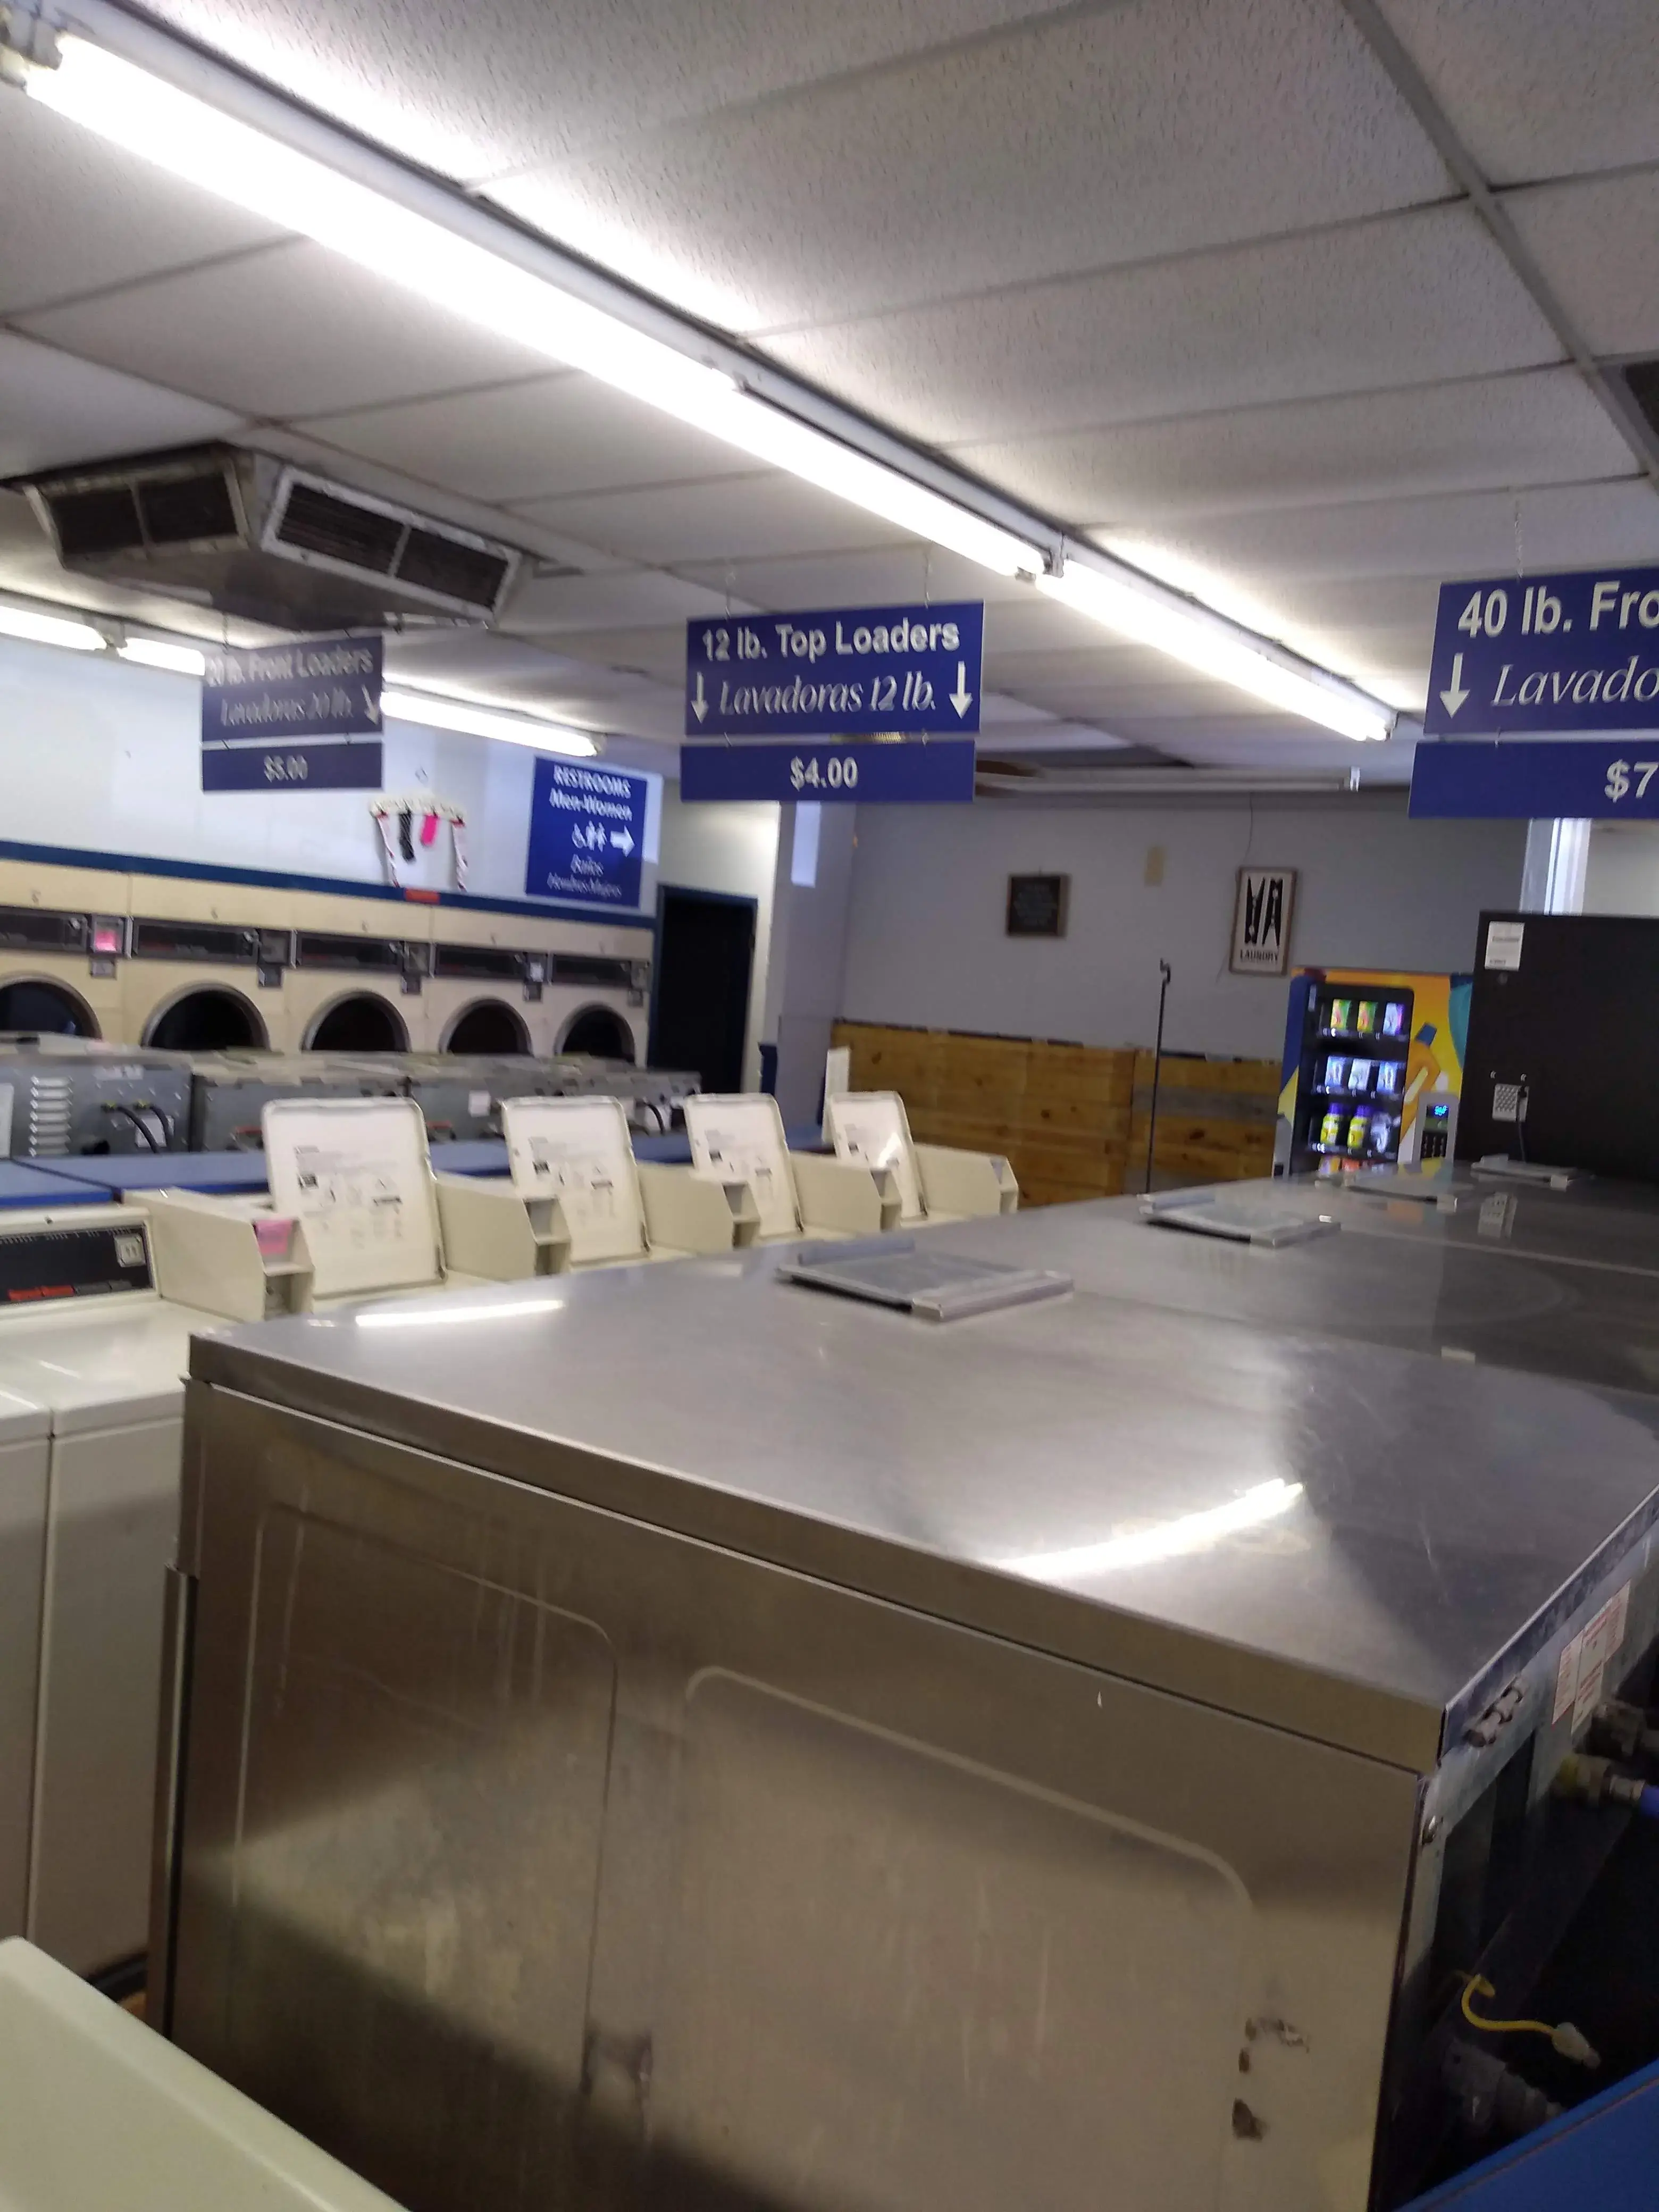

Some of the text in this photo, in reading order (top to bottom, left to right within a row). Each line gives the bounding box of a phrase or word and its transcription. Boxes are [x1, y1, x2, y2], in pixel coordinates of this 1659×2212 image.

[1458, 580, 1659, 638] 40 lb. Fro
[703, 617, 961, 664] 12 lb. Top Loaders
[296, 644, 373, 678] Loaders
[719, 671, 936, 715] Lavadoras 12 lb.
[1490, 655, 1659, 707] Lavado
[220, 692, 307, 726] Lavadoras
[263, 755, 308, 782] $5.00
[554, 765, 632, 799] RESTROOMS
[790, 756, 858, 792] $4.00
[549, 787, 633, 822] Men-Women
[1240, 949, 1278, 963] LAUNDRY
